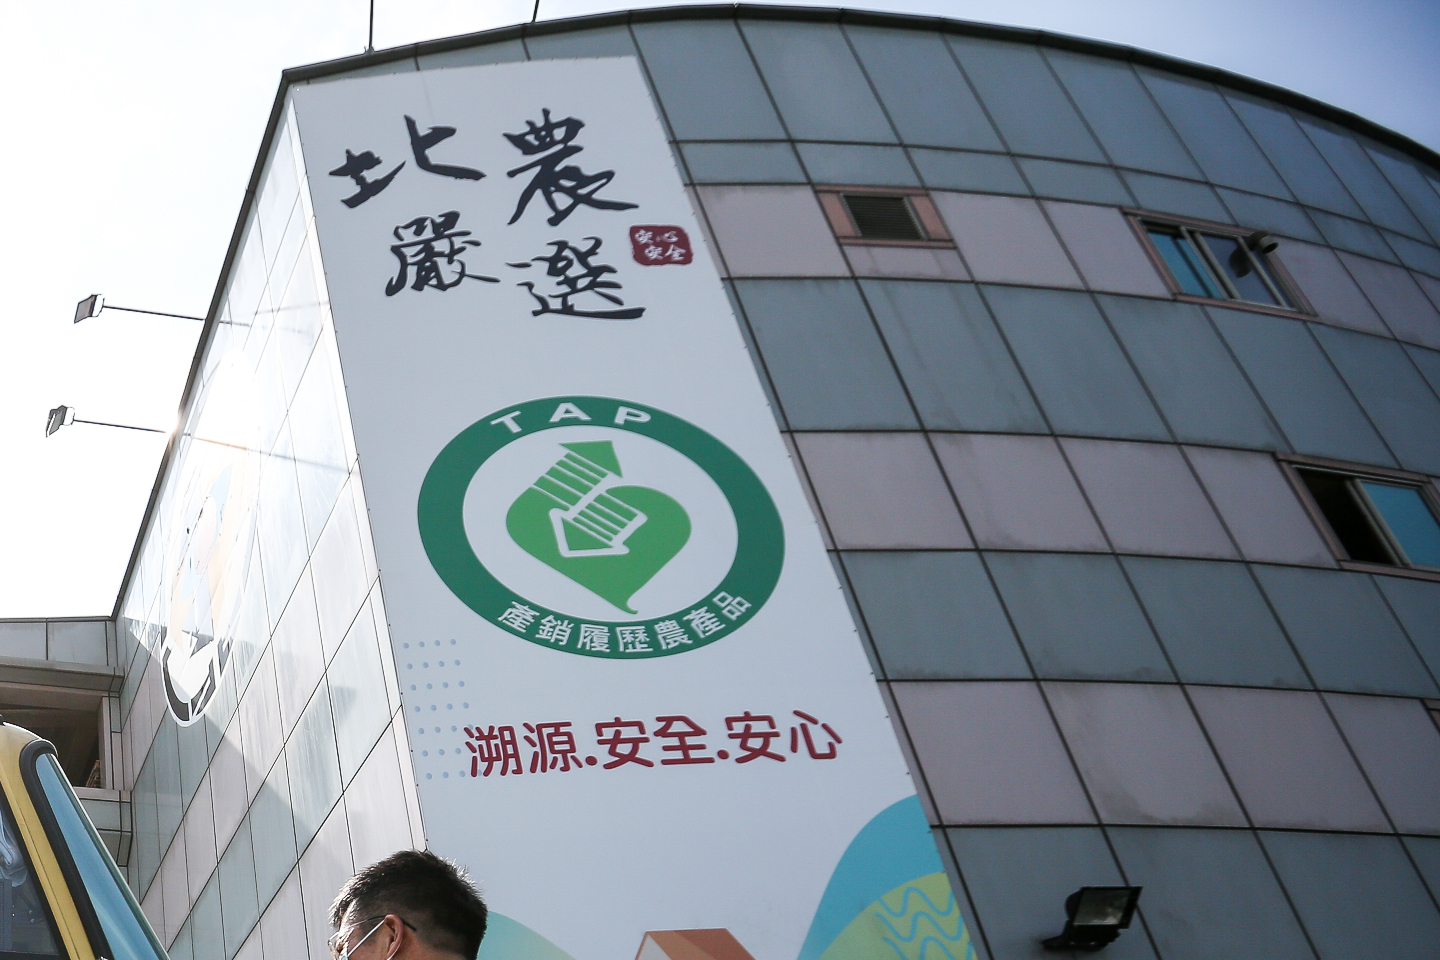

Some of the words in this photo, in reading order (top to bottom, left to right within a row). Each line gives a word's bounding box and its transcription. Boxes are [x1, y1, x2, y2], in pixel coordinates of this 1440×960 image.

[329, 108, 640, 226] 北農
[385, 210, 646, 320] 嚴選
[491, 401, 652, 434] TAP
[497, 590, 753, 653] 產銷履歷農產品
